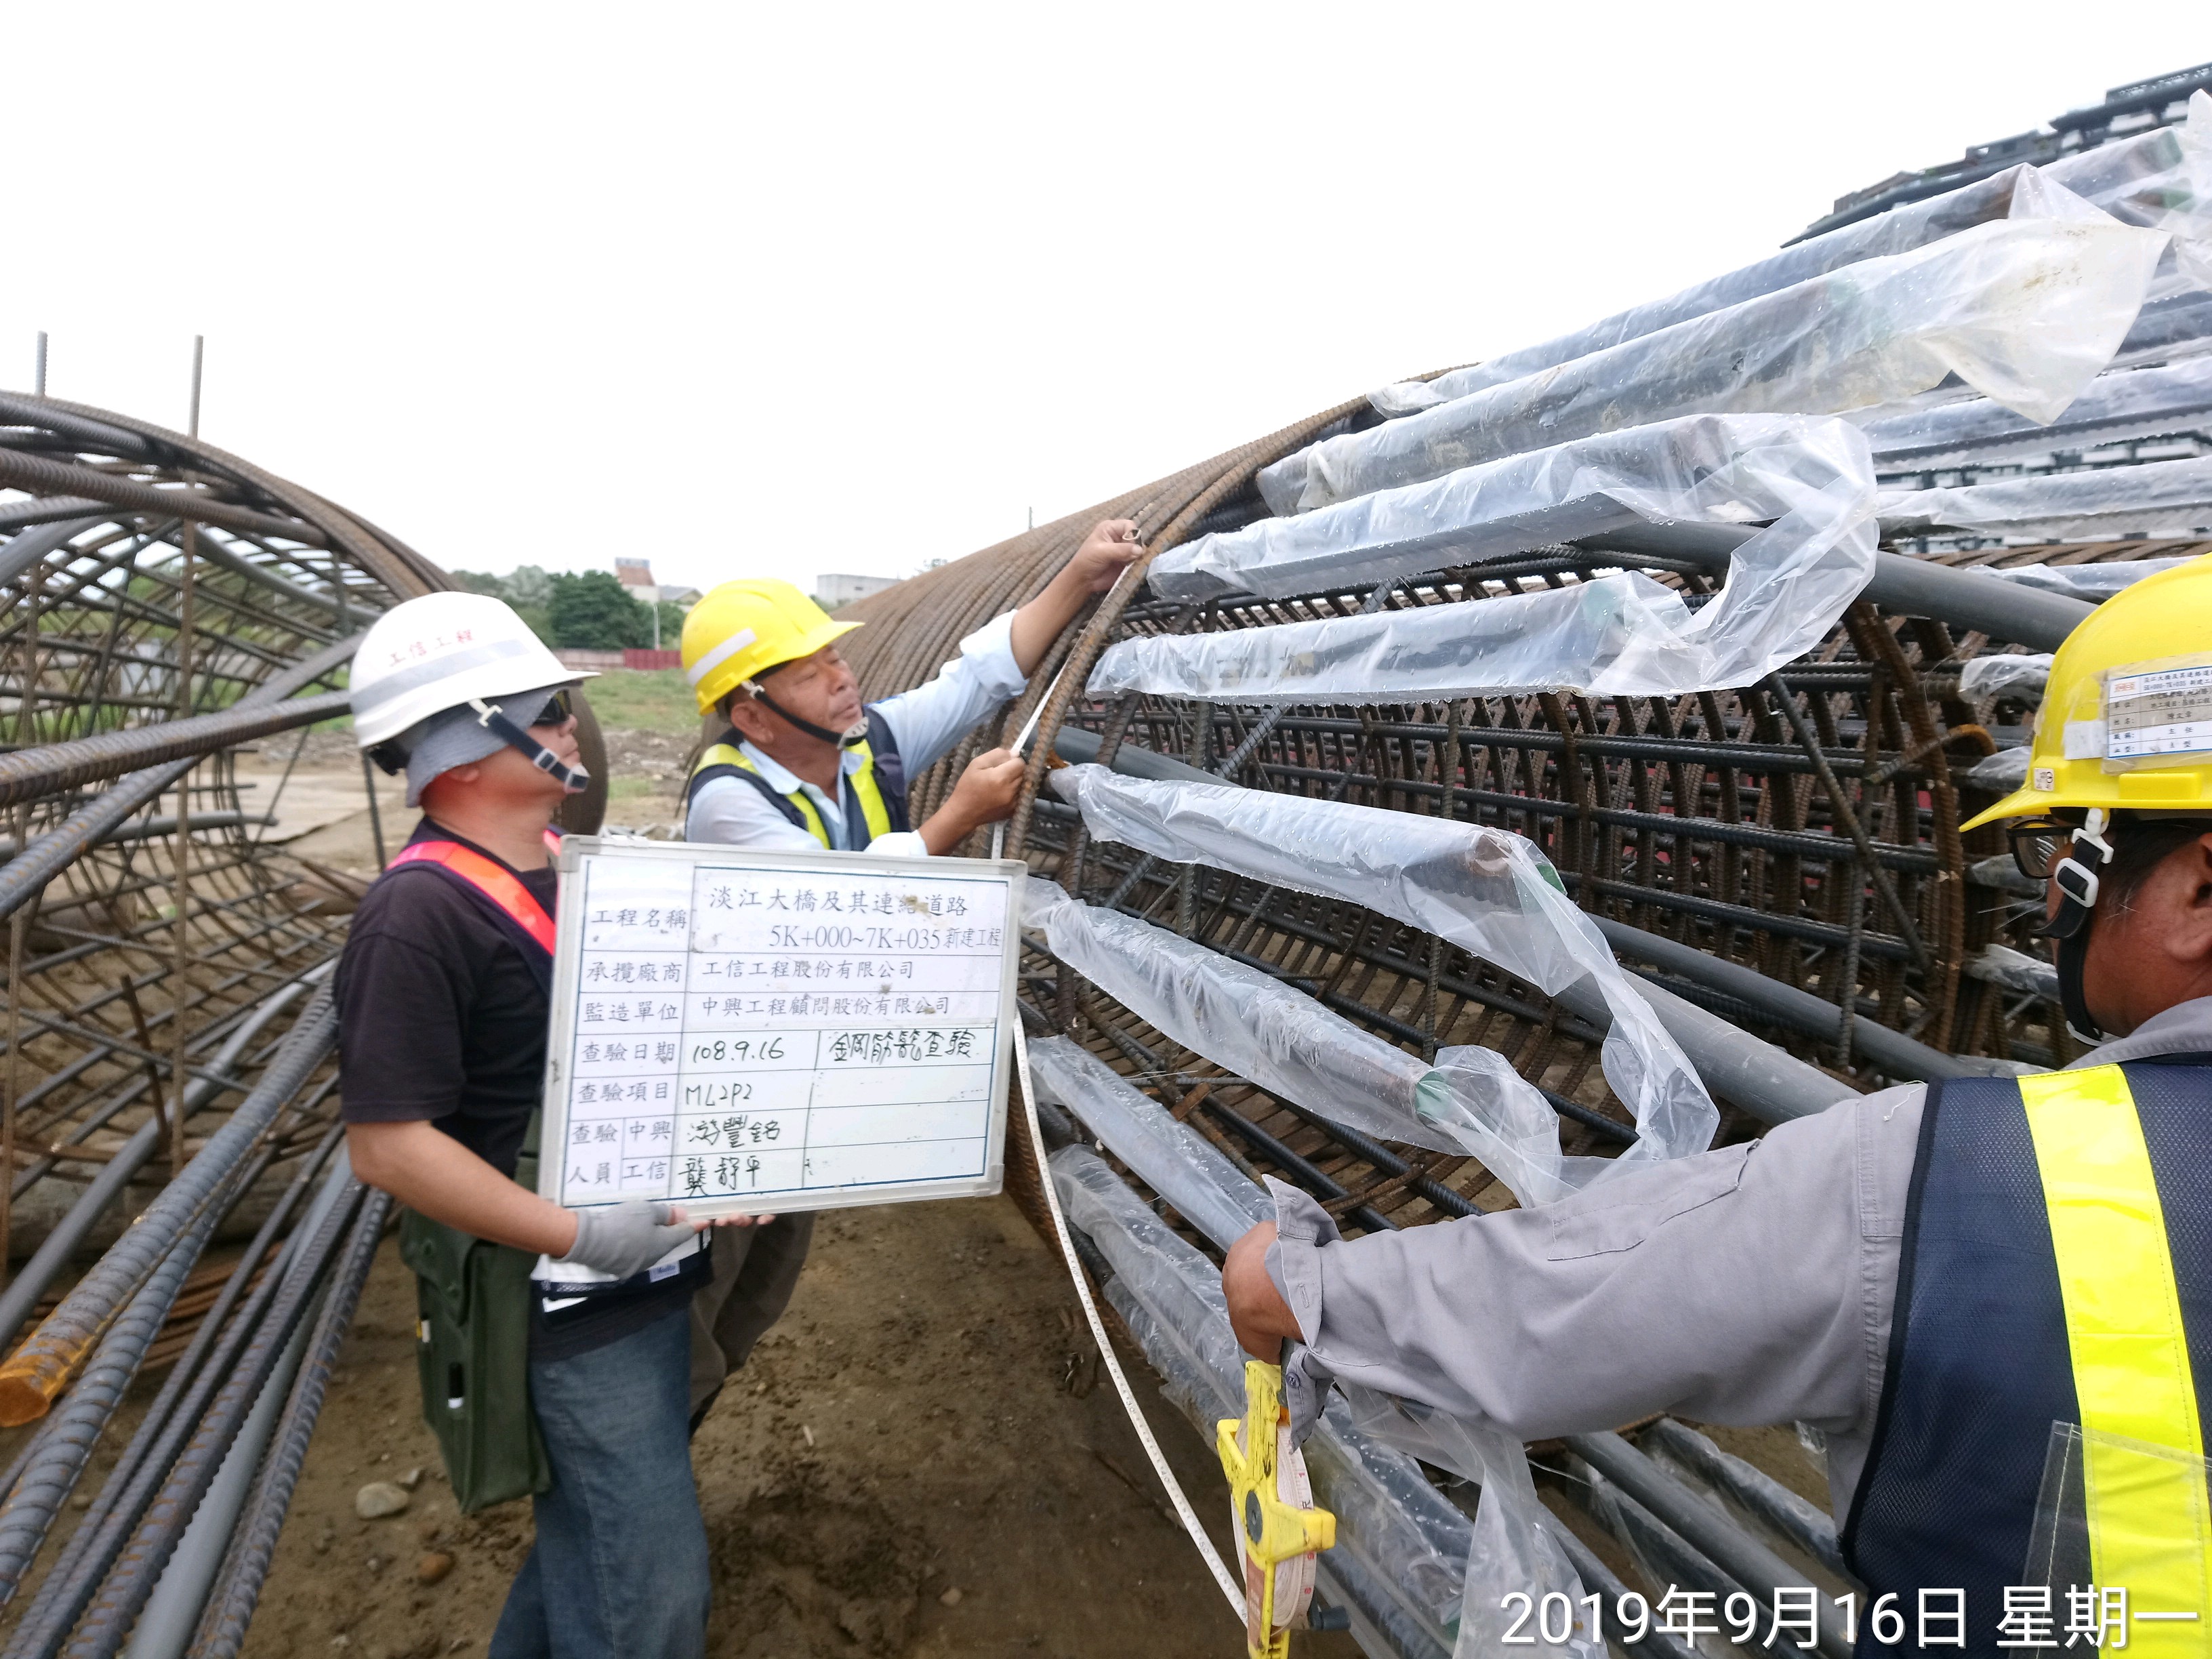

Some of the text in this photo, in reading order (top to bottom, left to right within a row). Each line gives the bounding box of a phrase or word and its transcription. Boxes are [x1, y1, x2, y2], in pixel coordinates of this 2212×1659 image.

[388, 629, 474, 668] 工信工程
[591, 908, 687, 929] 工程名稱
[943, 927, 1001, 948] 新建工程
[586, 961, 682, 983] 承攬廠商
[702, 959, 914, 979] 工信工程股份有限公司
[583, 1001, 678, 1023] 監造單位
[702, 996, 949, 1017] 中興工程顧問股份有限公司
[581, 1042, 676, 1064] 查驗日期
[693, 1037, 784, 1063] 108.9.16
[578, 1082, 668, 1104] 查驗項目
[685, 1082, 752, 1107] ML2P2
[571, 1122, 618, 1145] 查驗
[629, 1120, 672, 1141] 中興
[567, 1162, 611, 1185] 人員
[622, 1161, 667, 1181] 工信
